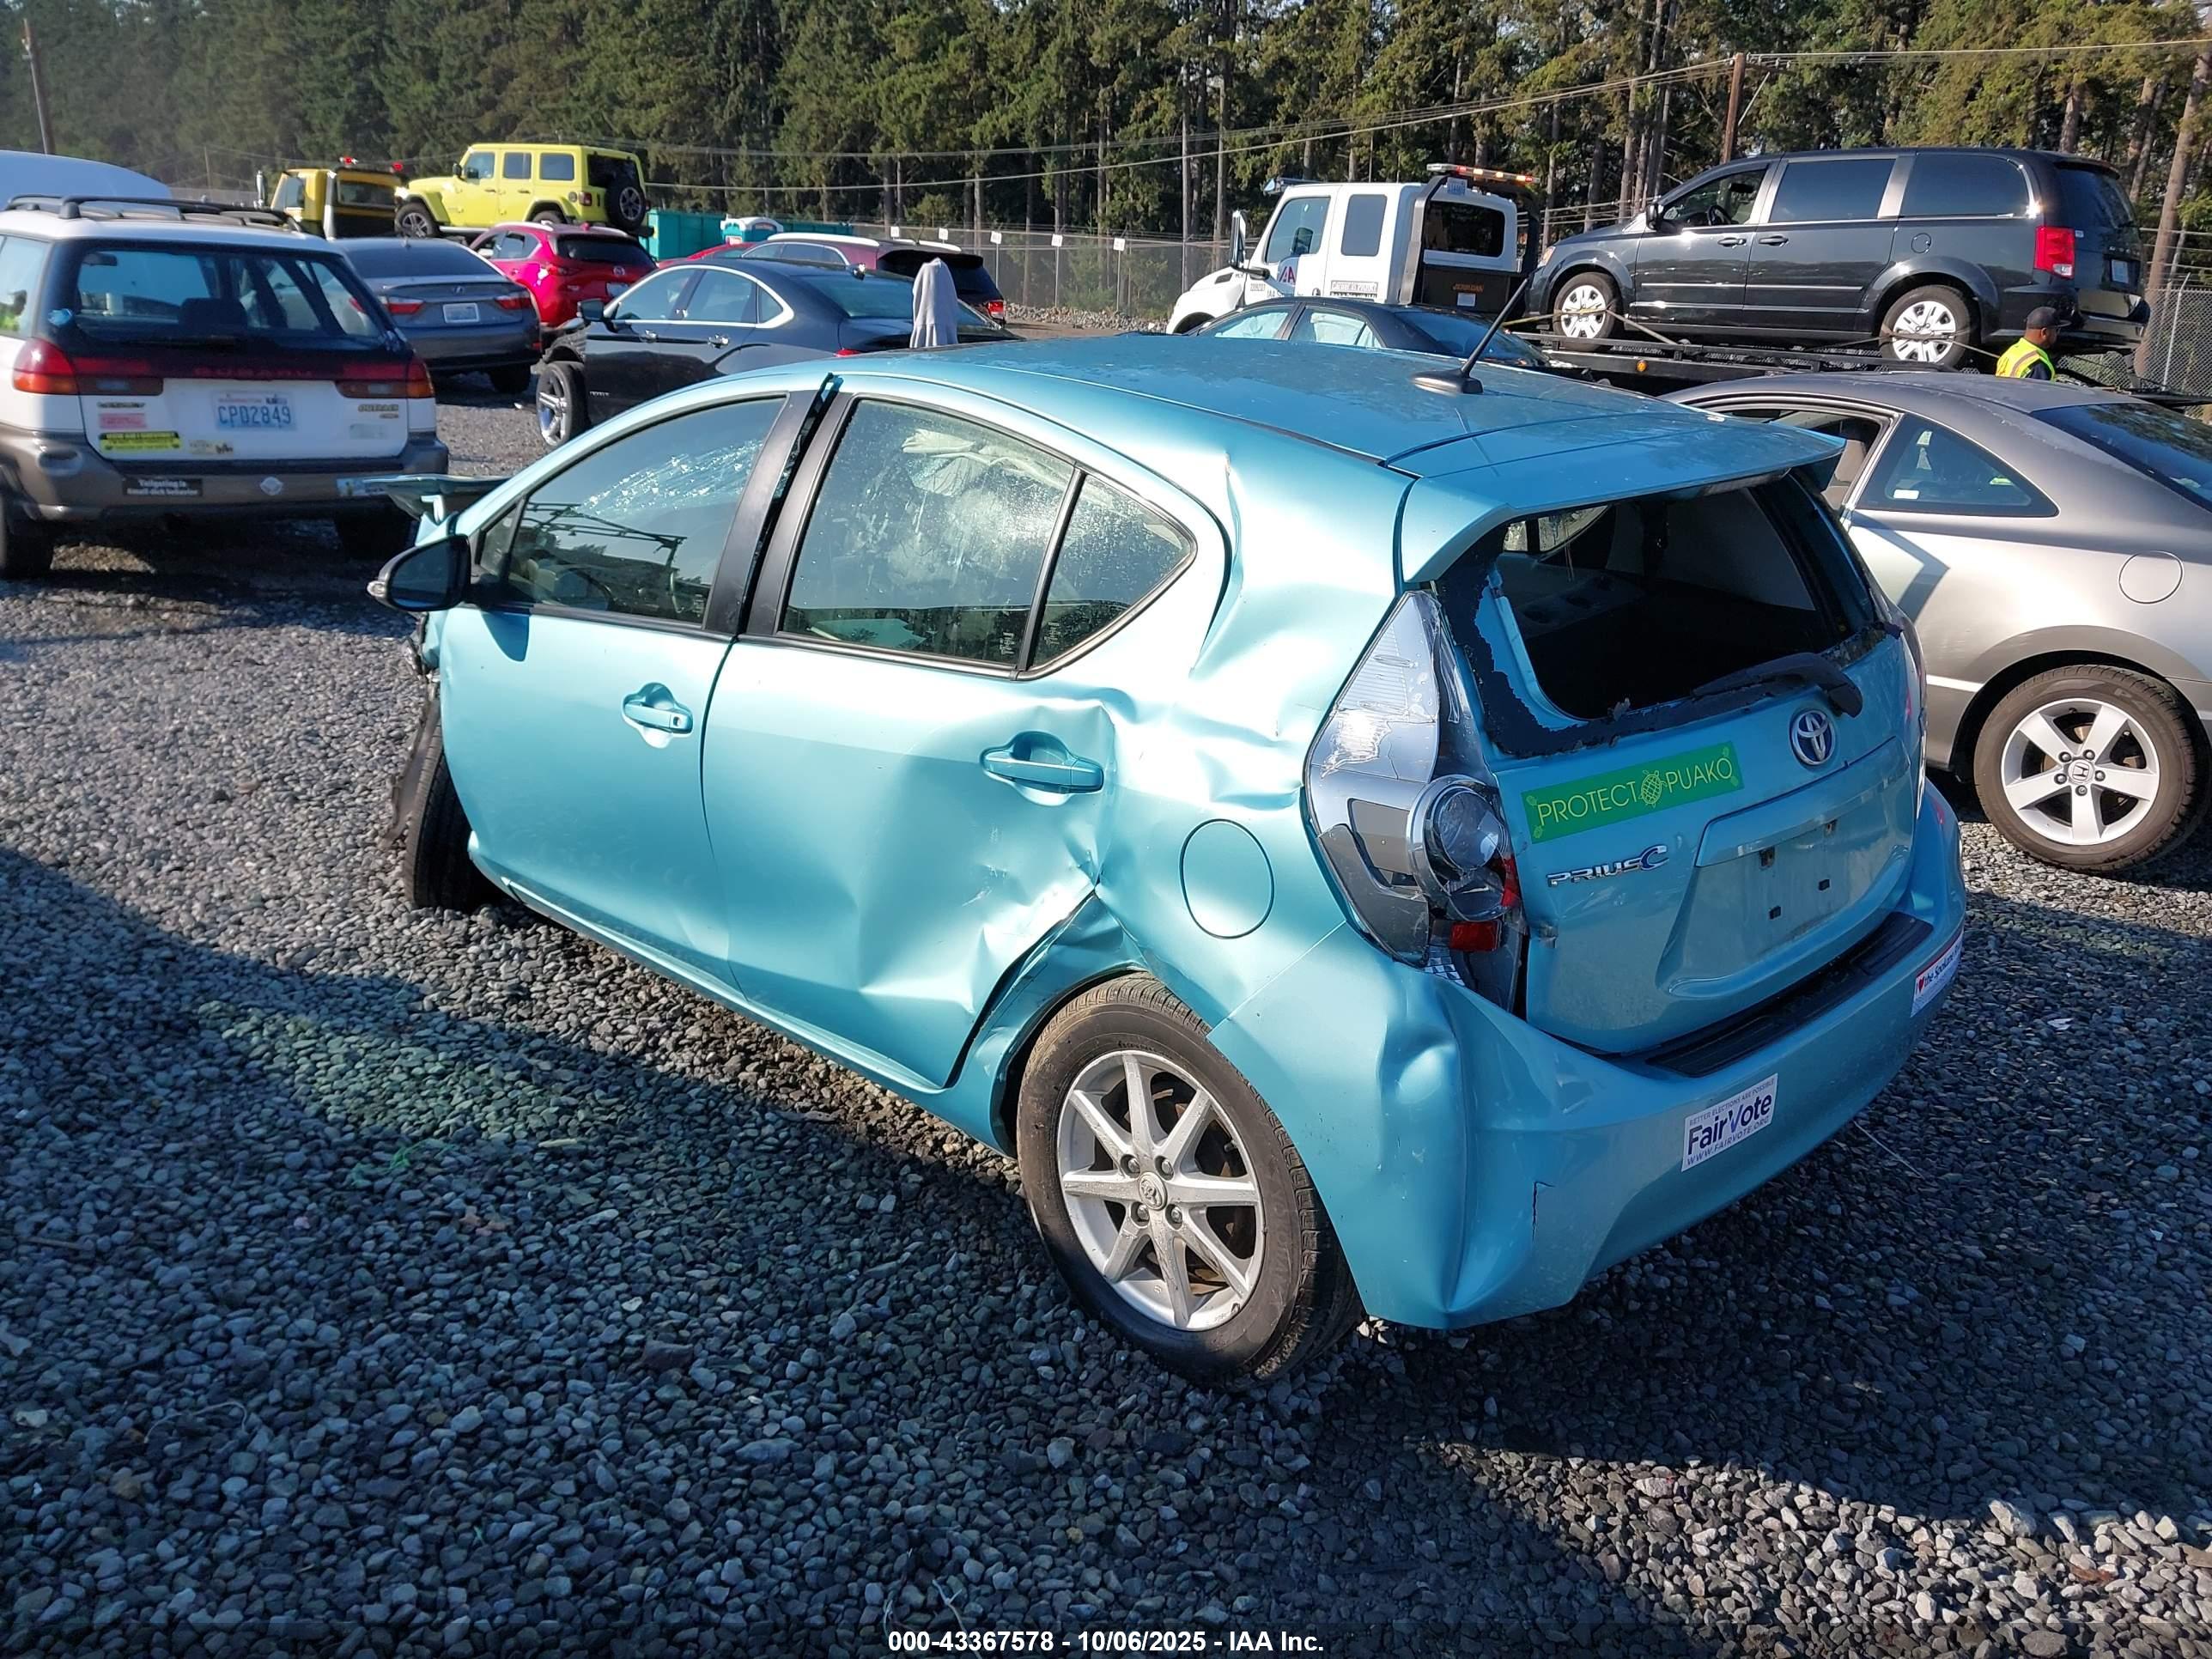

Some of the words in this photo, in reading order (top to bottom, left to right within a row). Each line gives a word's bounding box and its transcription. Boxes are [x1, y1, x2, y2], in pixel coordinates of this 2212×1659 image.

[218, 405, 291, 424] CPD2849
[1537, 781, 1638, 826] PROTECT
[1665, 757, 1733, 793] PUAKO
[1546, 856, 1642, 887] PRIUS
[1688, 1094, 1772, 1156] FairVote
[1689, 1111, 1711, 1127] BETTER
[1711, 1097, 1741, 1115] ELECTIONS
[1741, 1091, 1751, 1102] ARE
[1686, 1115, 1770, 1166] WWW.FAIRVOTE.ORG
